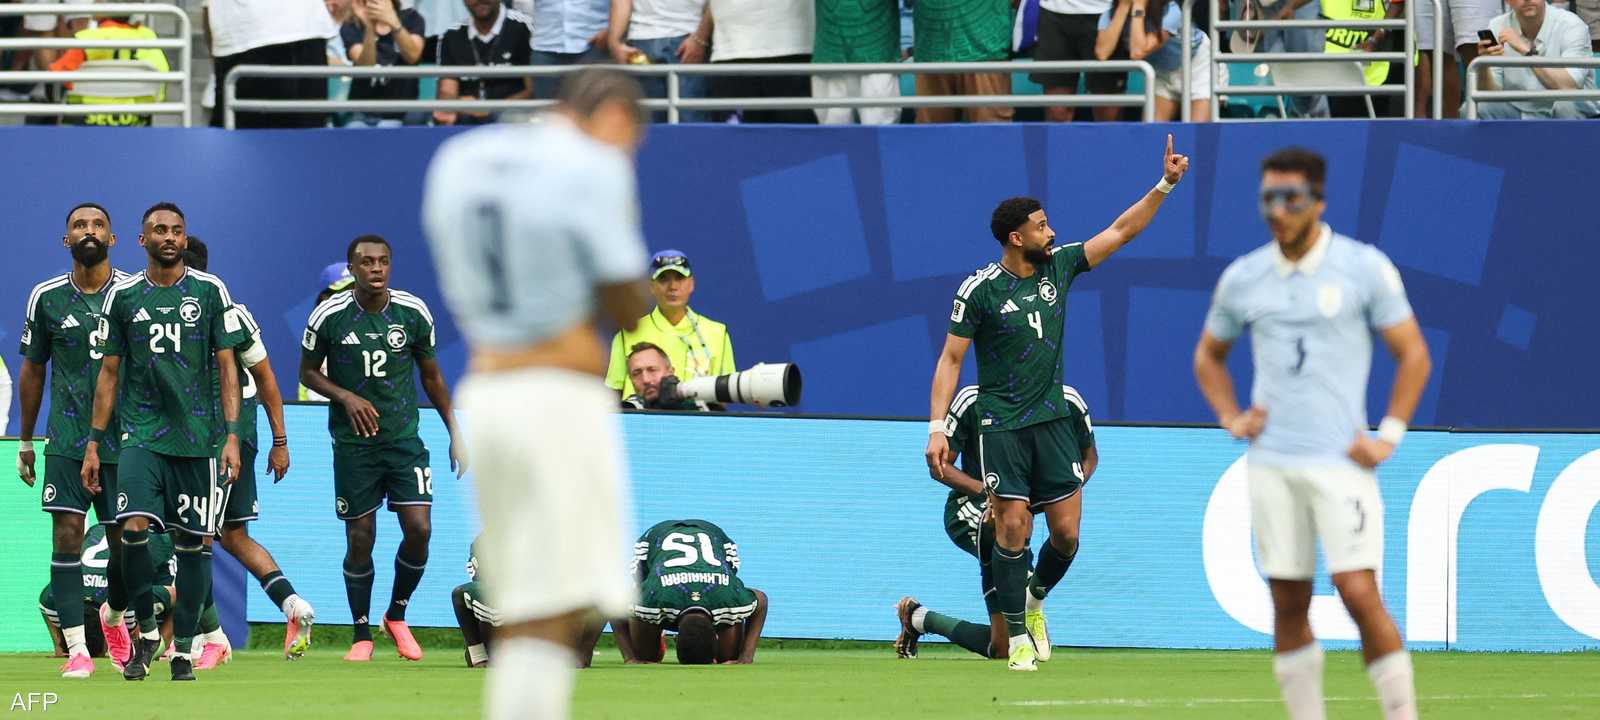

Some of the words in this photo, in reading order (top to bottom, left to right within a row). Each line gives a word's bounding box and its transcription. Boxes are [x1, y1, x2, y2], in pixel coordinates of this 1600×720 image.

[149, 323, 181, 353] 24
[1027, 310, 1043, 339] 4
[362, 350, 387, 377] 12
[177, 494, 208, 526] 24
[661, 532, 722, 568] 15
[660, 572, 729, 588] ALKHAIBARI
